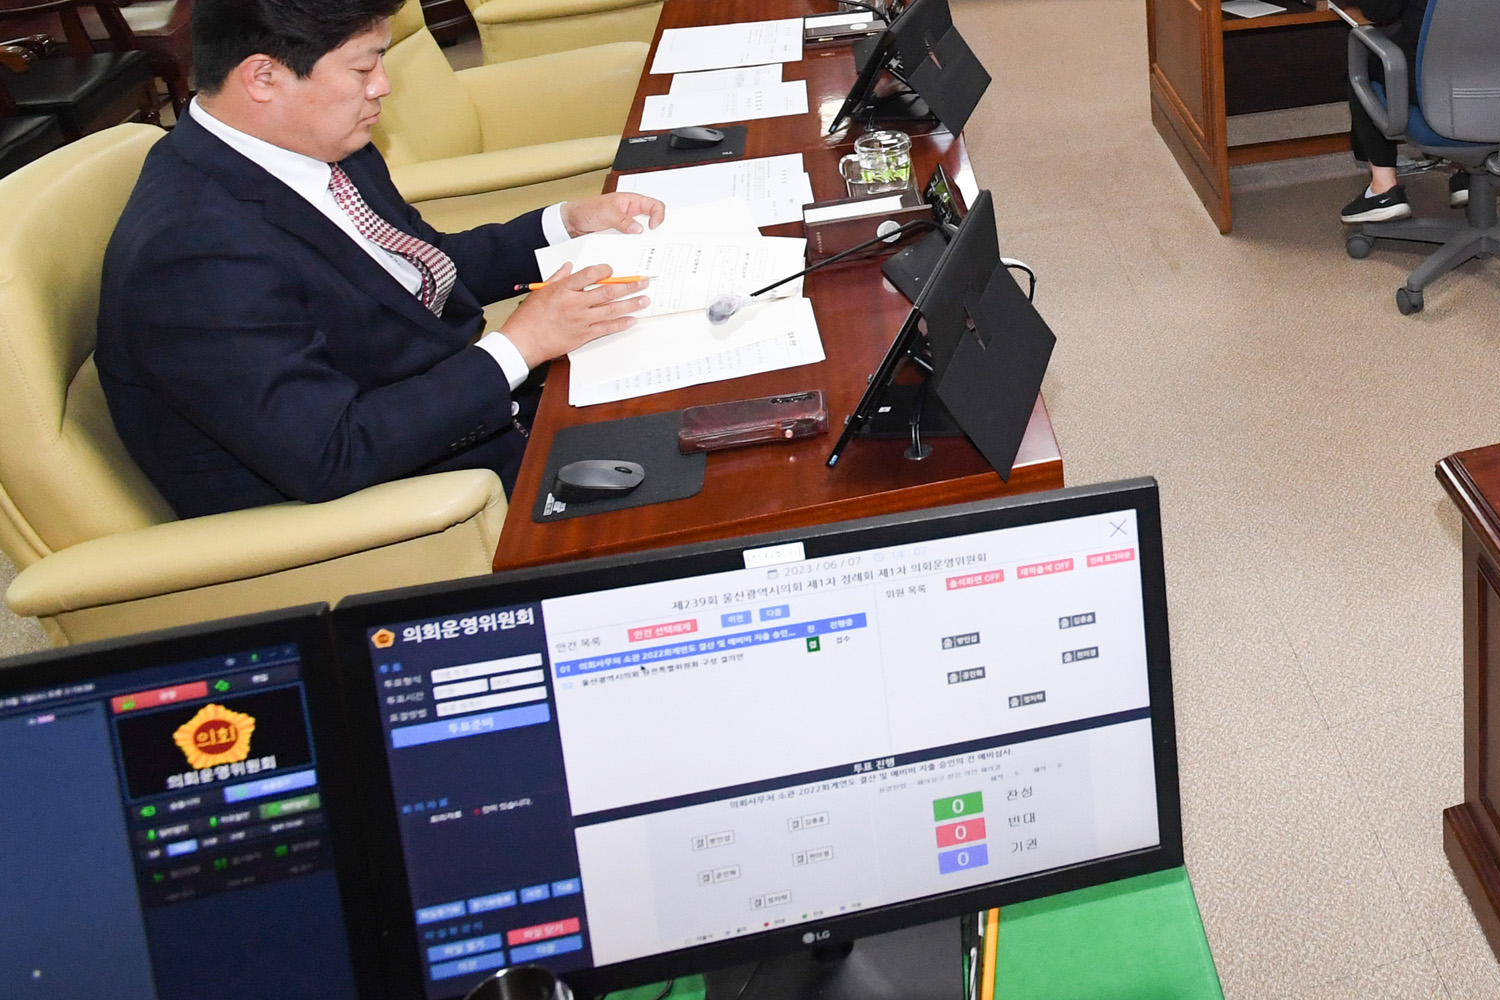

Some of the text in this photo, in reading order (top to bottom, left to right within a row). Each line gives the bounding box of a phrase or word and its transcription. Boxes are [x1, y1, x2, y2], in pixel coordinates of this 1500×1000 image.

[783, 563, 813, 576] 2023
[823, 559, 837, 570] 06
[847, 556, 861, 566] 07
[1054, 560, 1070, 571] OFF
[984, 571, 1001, 582] OFF
[671, 594, 718, 612] 제239회
[722, 581, 802, 604] 울산광역시의회
[403, 608, 534, 643] 의회운영위원회
[558, 664, 571, 674] 01
[195, 726, 237, 748] 의회
[952, 799, 964, 813] 0
[955, 825, 967, 840] 0
[957, 852, 969, 867] 0
[817, 930, 830, 940] LG
